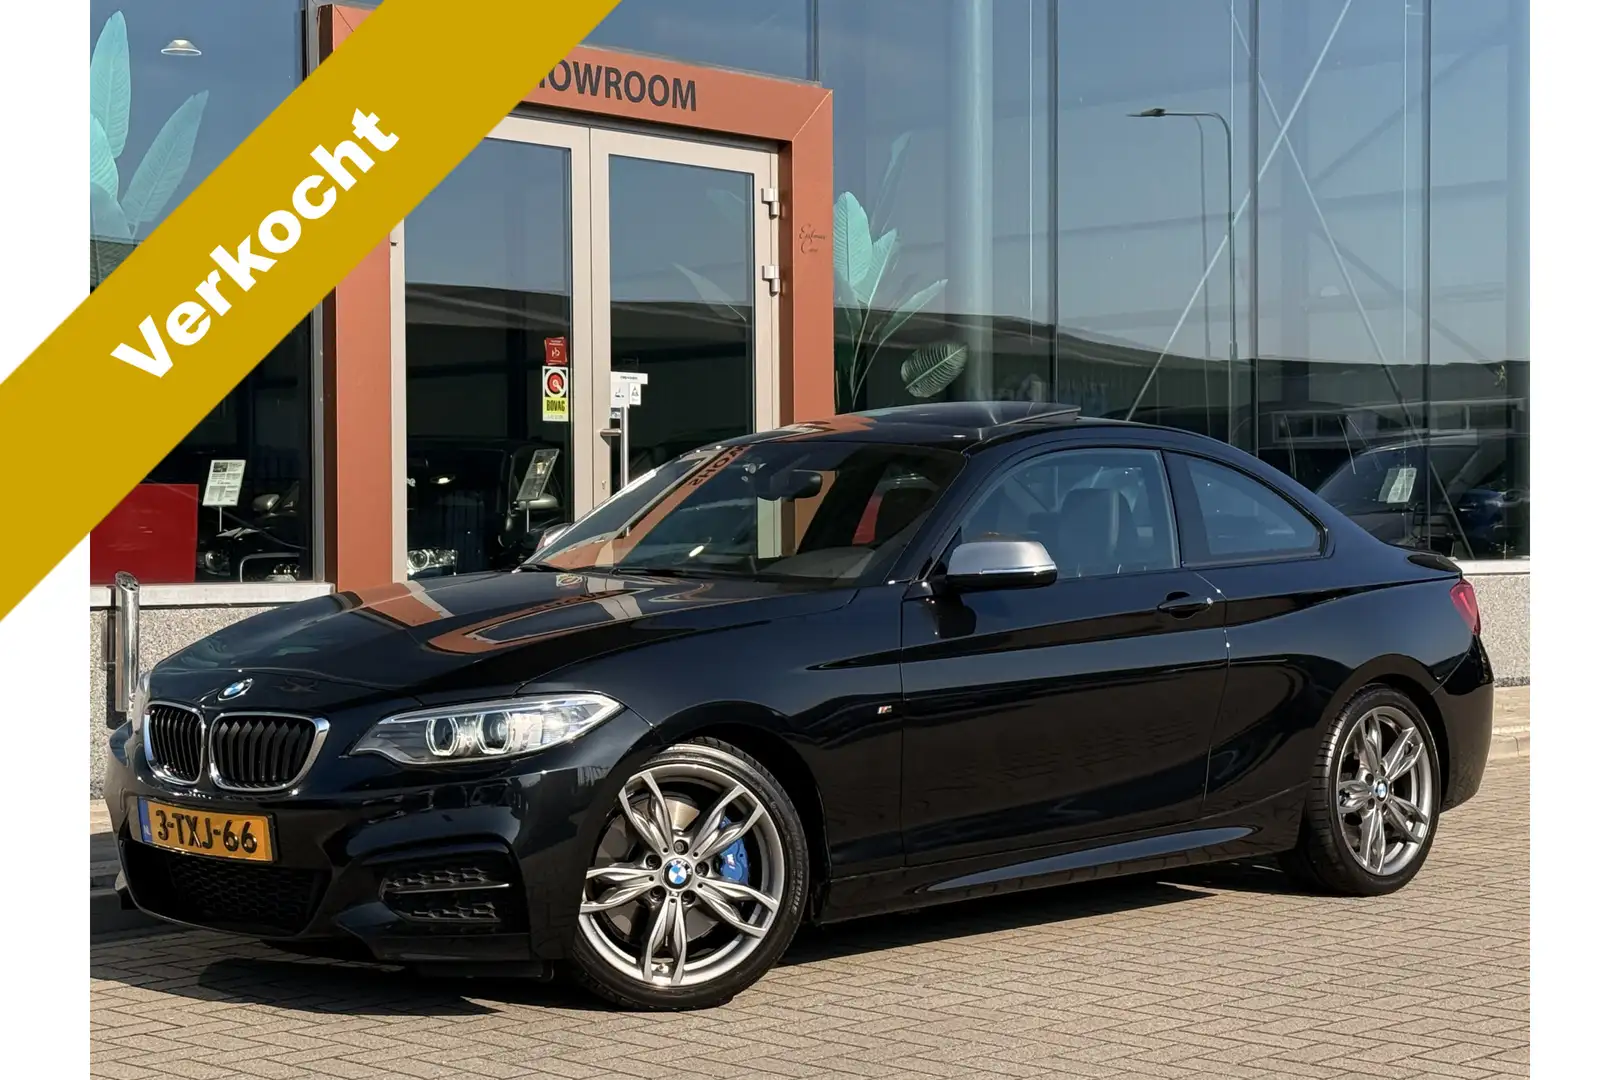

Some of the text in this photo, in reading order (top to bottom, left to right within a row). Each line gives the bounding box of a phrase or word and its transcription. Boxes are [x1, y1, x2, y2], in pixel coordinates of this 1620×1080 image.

[539, 59, 697, 111] OWROOM
[546, 400, 566, 412] BOVAG
[155, 809, 258, 854] 3-TXJ-66
